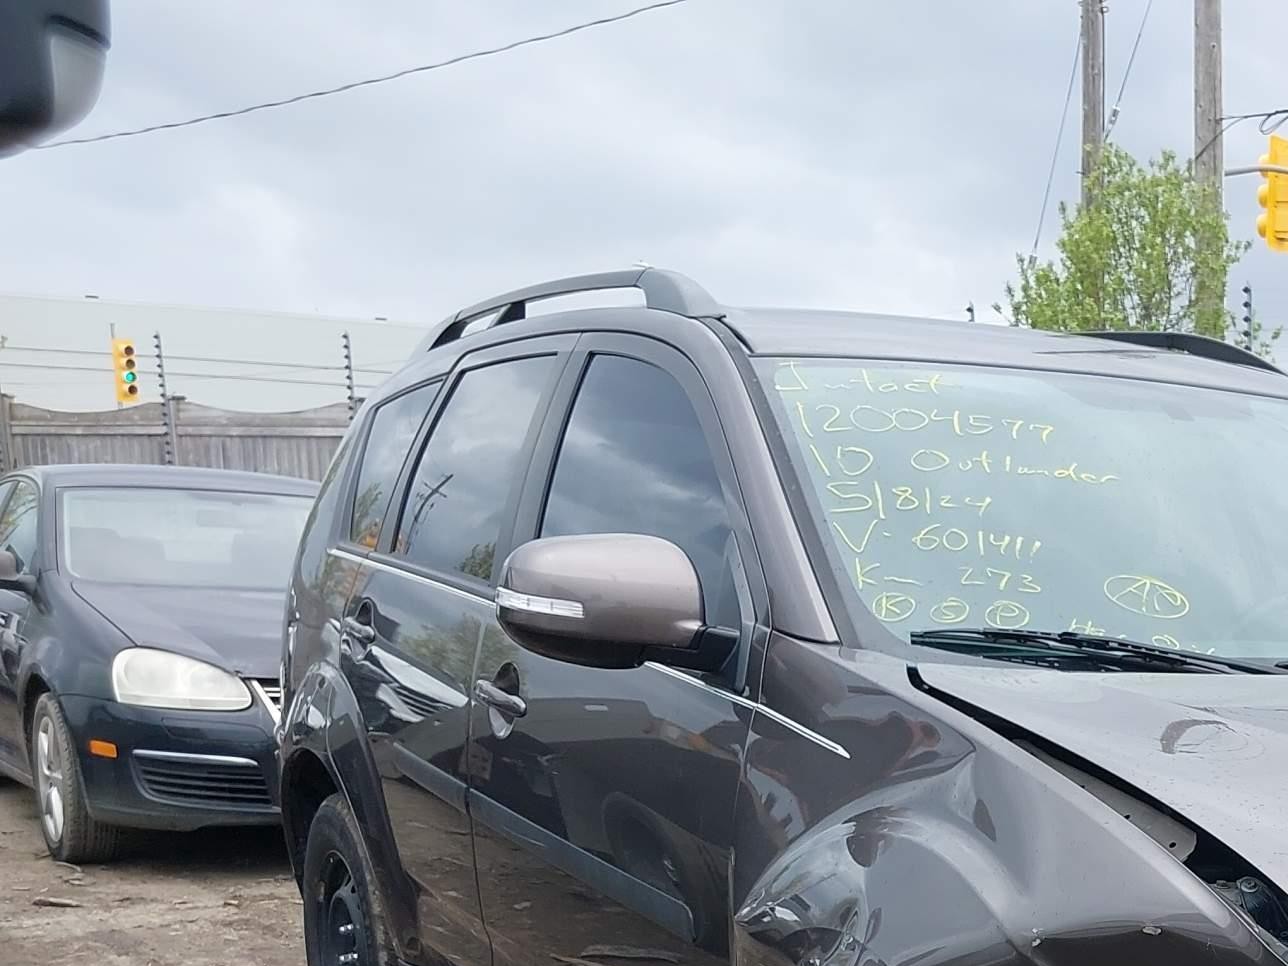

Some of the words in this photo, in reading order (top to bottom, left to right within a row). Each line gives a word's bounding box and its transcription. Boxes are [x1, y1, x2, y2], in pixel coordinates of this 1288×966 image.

[797, 401, 1054, 443] 12004577
[809, 444, 874, 477] 10
[958, 566, 1042, 593] 273
